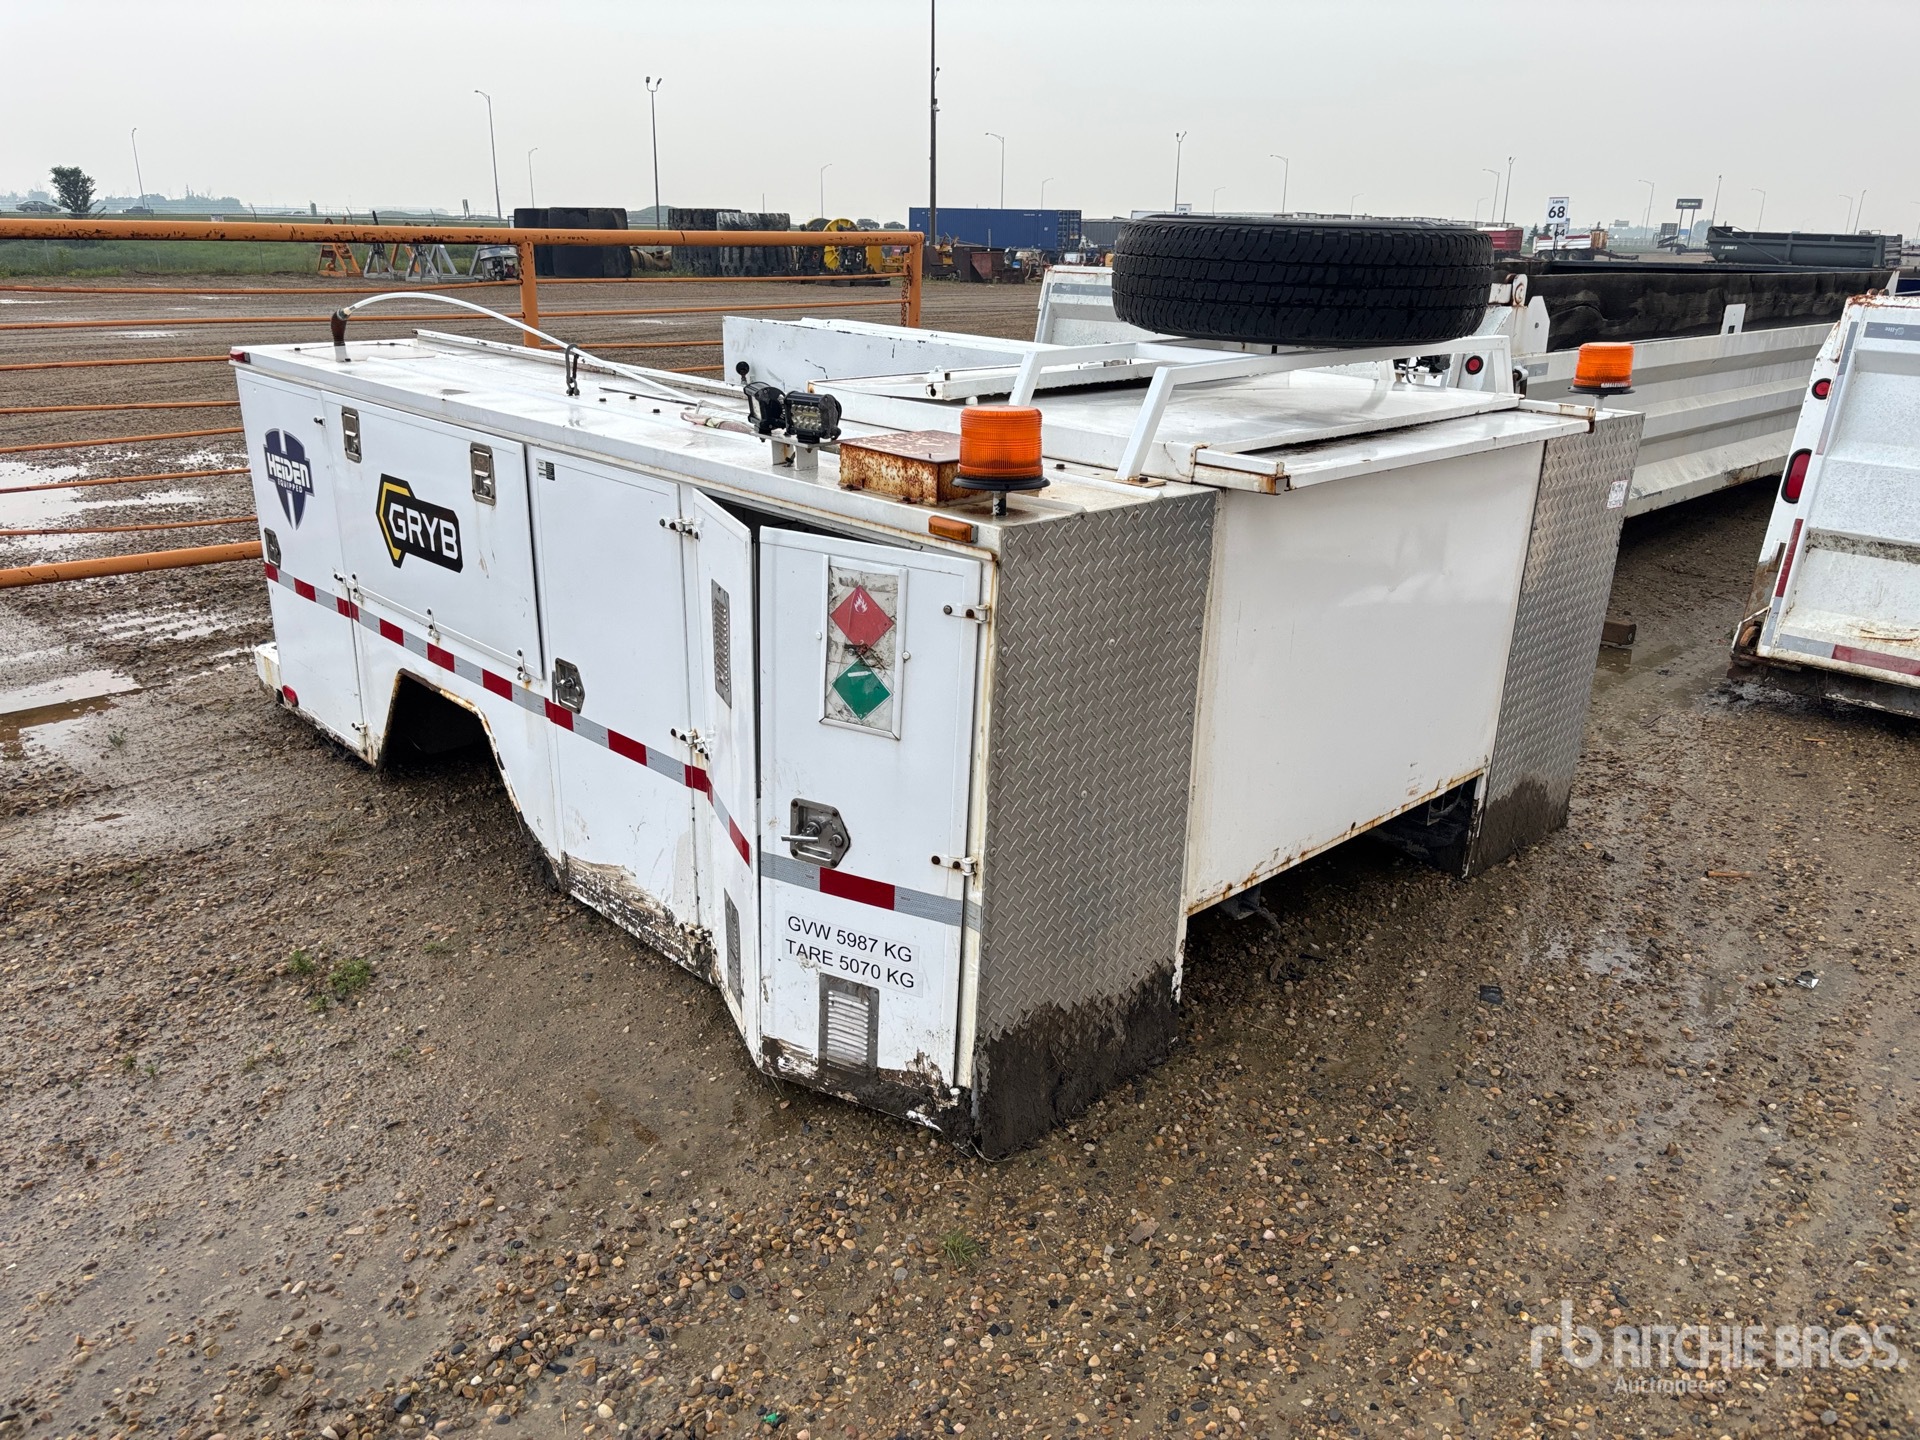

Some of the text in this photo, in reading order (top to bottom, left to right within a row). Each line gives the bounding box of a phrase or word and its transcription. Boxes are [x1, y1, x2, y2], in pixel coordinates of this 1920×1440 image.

[1548, 206, 1566, 218] 68
[1554, 229, 1565, 237] 64
[266, 452, 311, 489] HEIDEN
[277, 479, 303, 493] EQUIPPED
[388, 502, 459, 560] GRYB
[787, 915, 912, 963] GVW 5987 KG
[785, 938, 915, 989] TARE 5070 KG
